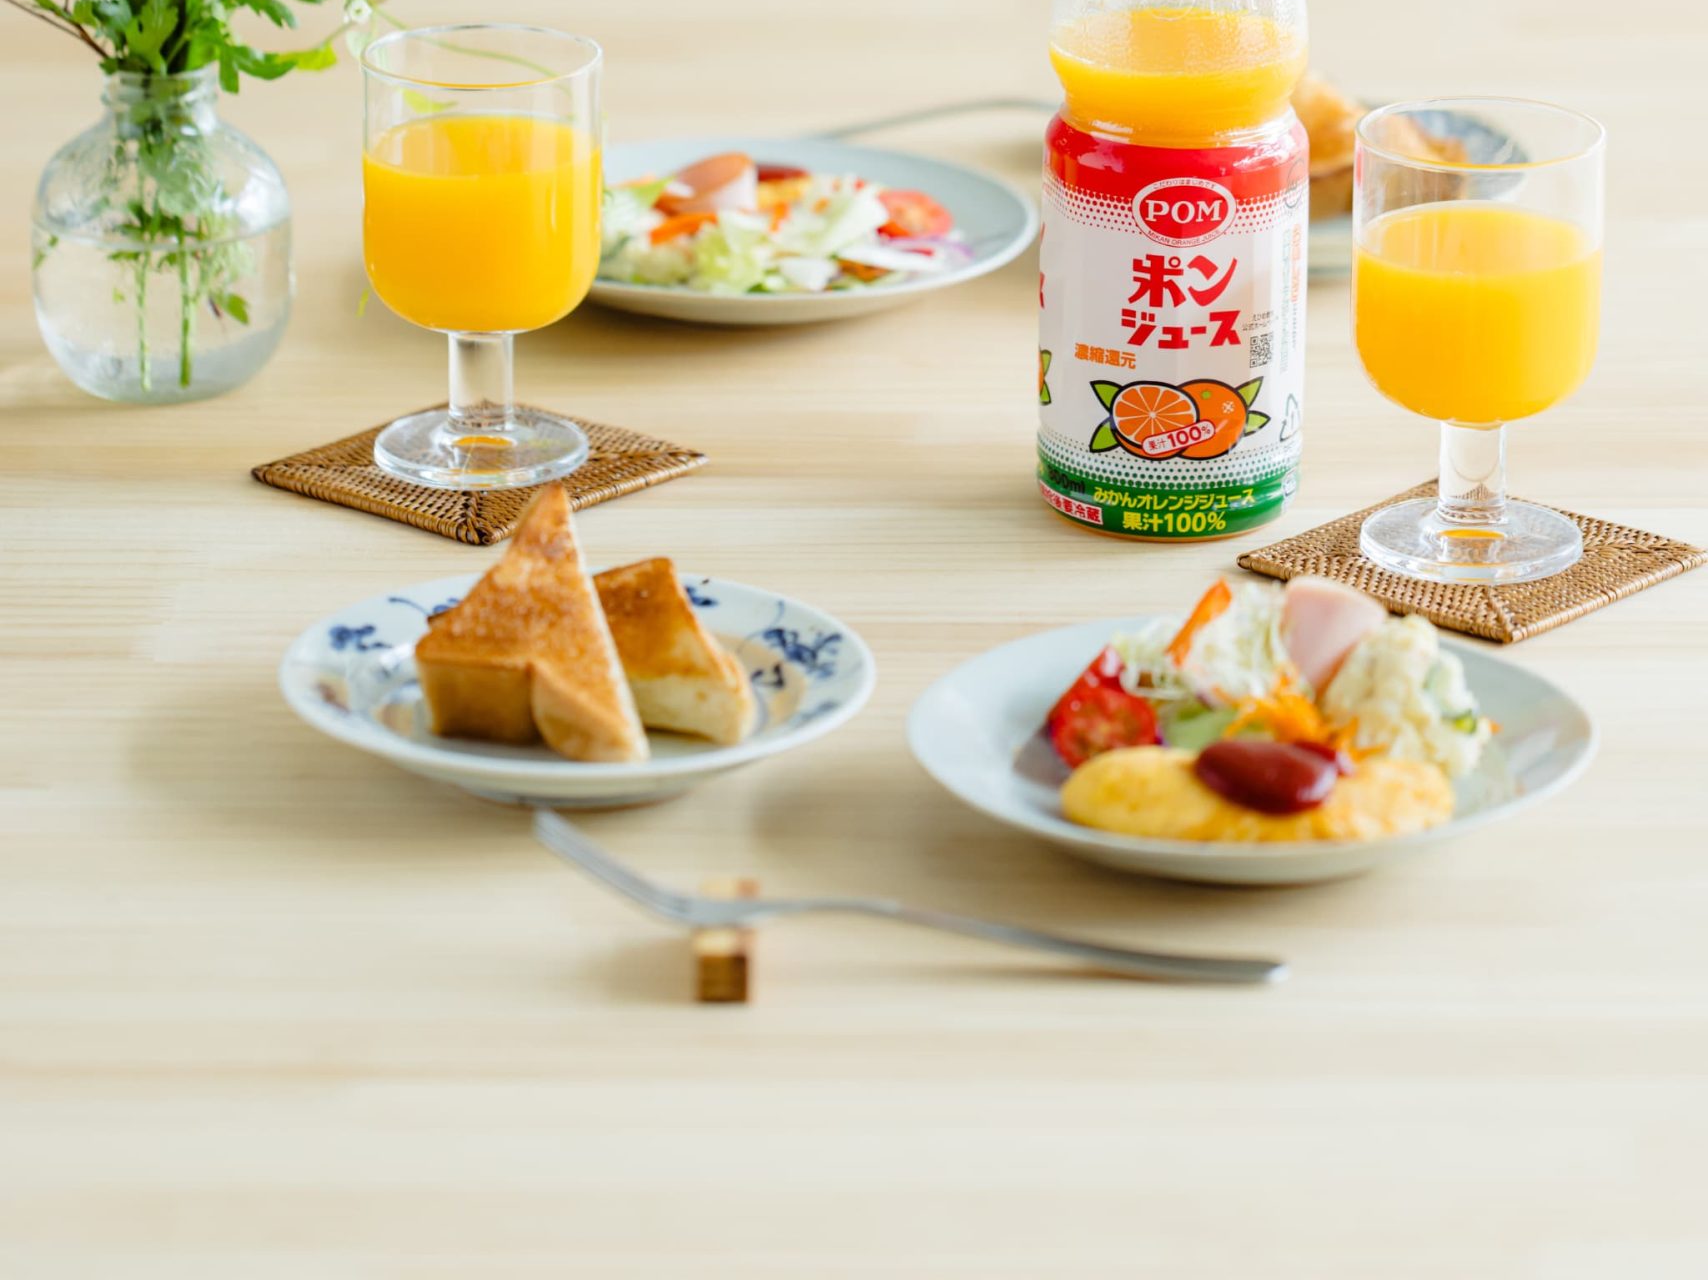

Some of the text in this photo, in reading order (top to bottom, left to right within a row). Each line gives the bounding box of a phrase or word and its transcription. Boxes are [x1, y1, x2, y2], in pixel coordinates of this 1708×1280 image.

[1145, 199, 1222, 224] POM
[1148, 230, 1170, 244] MIKAN
[1171, 238, 1200, 246] ORANGE
[1128, 253, 1238, 308] ポン
[1121, 308, 1241, 349] ジュース
[1074, 342, 1137, 370] 濃縮還元
[1148, 424, 1211, 451] 果汁100%
[1093, 486, 1256, 511] みかんオレンジジュース
[1122, 511, 1227, 533] 果汁100%
